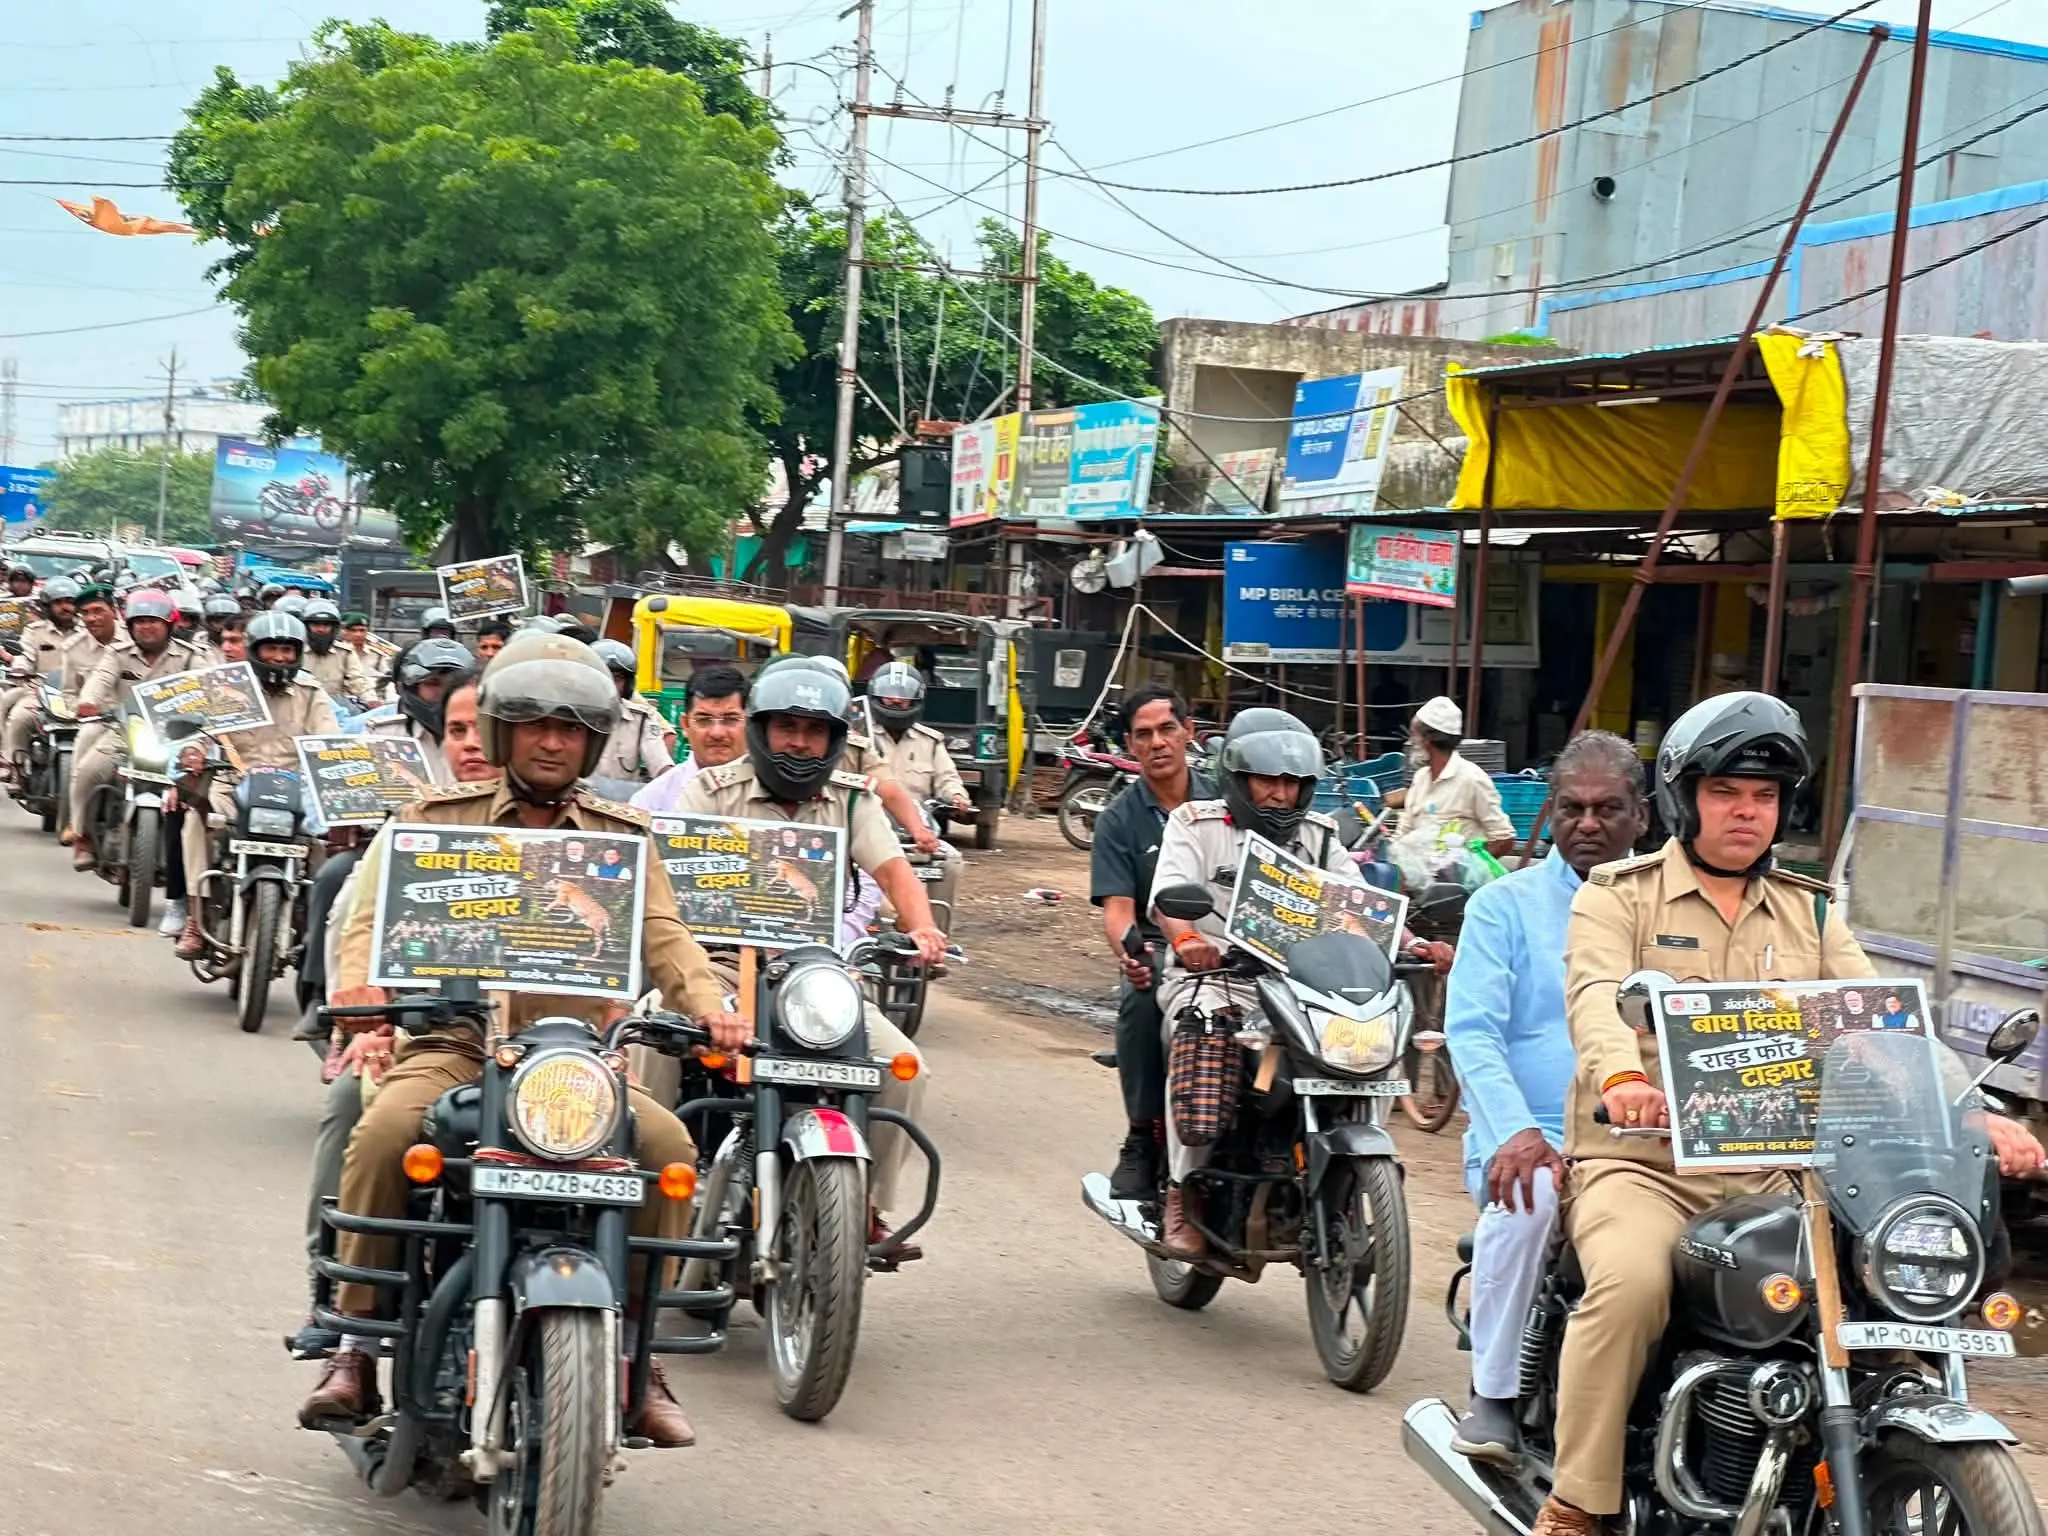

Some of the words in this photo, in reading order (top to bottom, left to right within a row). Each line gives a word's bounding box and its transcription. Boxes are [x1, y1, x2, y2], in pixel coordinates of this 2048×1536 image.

[1239, 587, 1267, 601] MP
[1269, 588, 1320, 601] BIRLA
[414, 852, 462, 869] बाघ
[465, 850, 522, 872] दिवस
[416, 884, 465, 902] राइड
[469, 878, 509, 896] फॉर
[446, 898, 522, 919] टाइगर
[1689, 1014, 1740, 1033] बाघ
[1743, 1009, 1802, 1031] दिवस
[1701, 1048, 1751, 1068] राइड
[1755, 1038, 1797, 1060] फॉर
[1737, 1059, 1815, 1087] टाइगर
